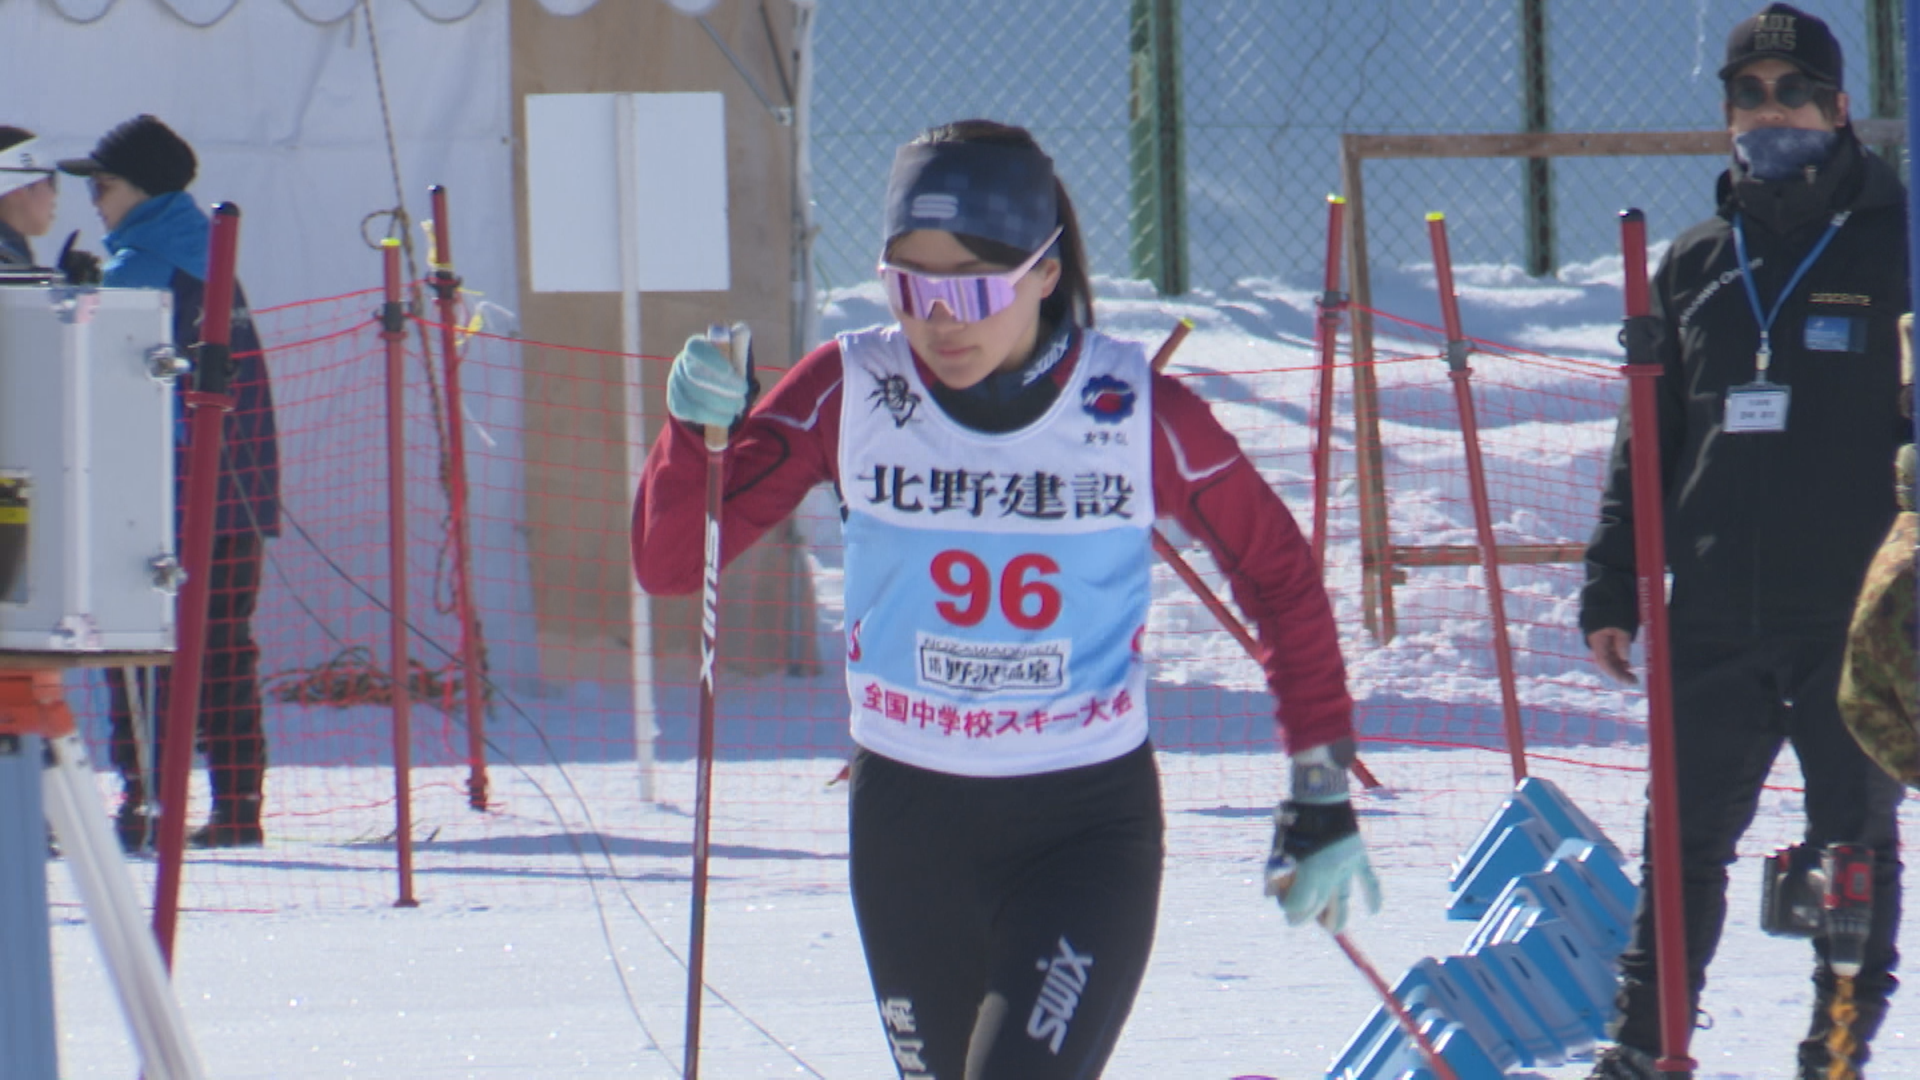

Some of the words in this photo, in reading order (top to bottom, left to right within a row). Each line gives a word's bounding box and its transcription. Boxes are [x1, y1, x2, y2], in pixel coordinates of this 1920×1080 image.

[857, 464, 1134, 520] 北野建設
[929, 549, 1062, 630] 96
